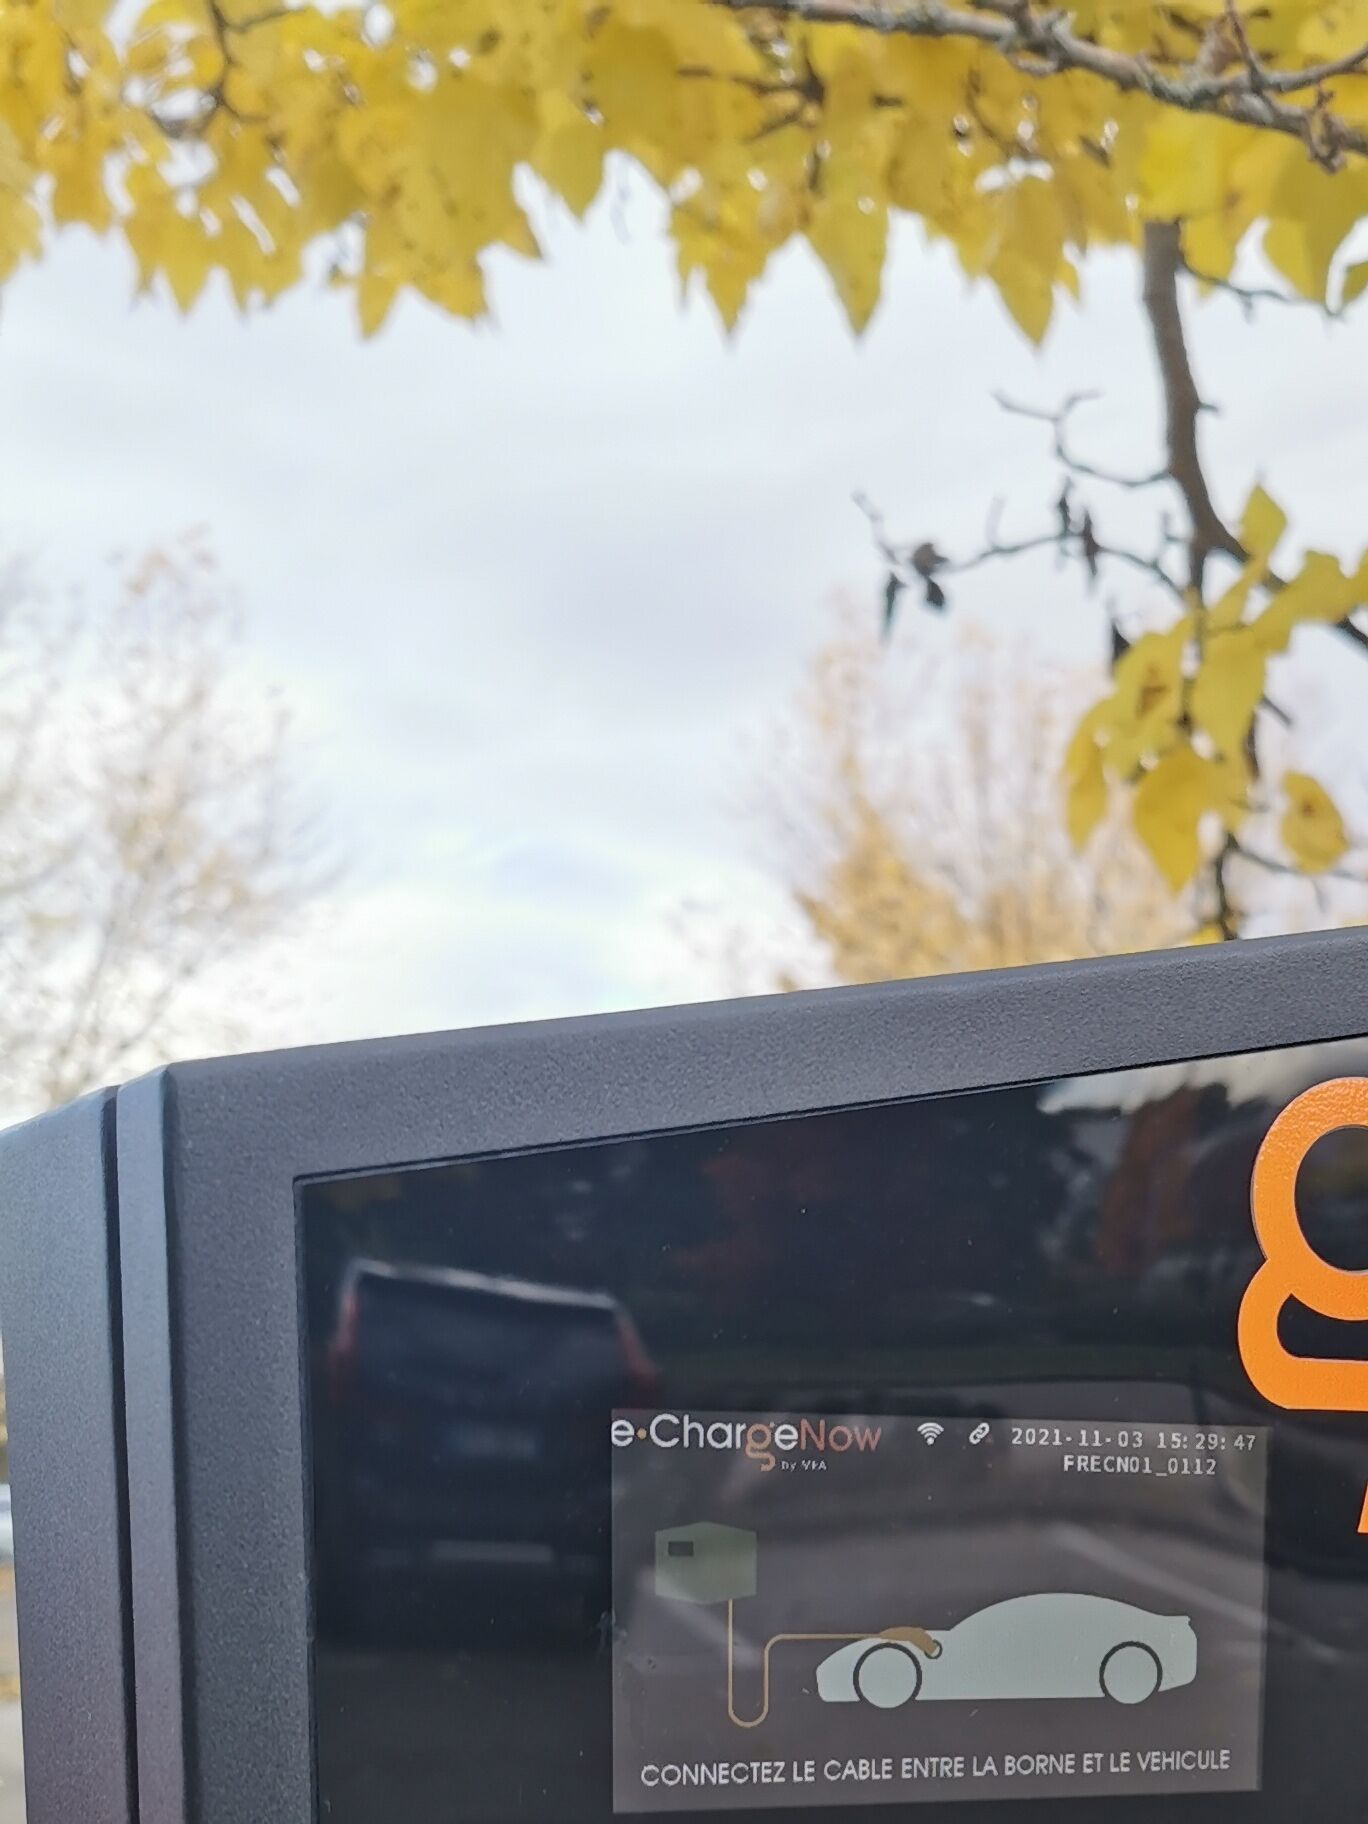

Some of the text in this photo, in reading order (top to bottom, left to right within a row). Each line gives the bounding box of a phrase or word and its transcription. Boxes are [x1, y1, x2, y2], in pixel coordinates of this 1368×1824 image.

[1011, 1428, 1143, 1448] 2021-11-03
[1063, 1454, 1216, 1476] FRECN01_0112
[641, 1749, 1231, 1786] CONNECTEZ LE CABLE ENTRE LA BORNE ET LE VEHICULE
